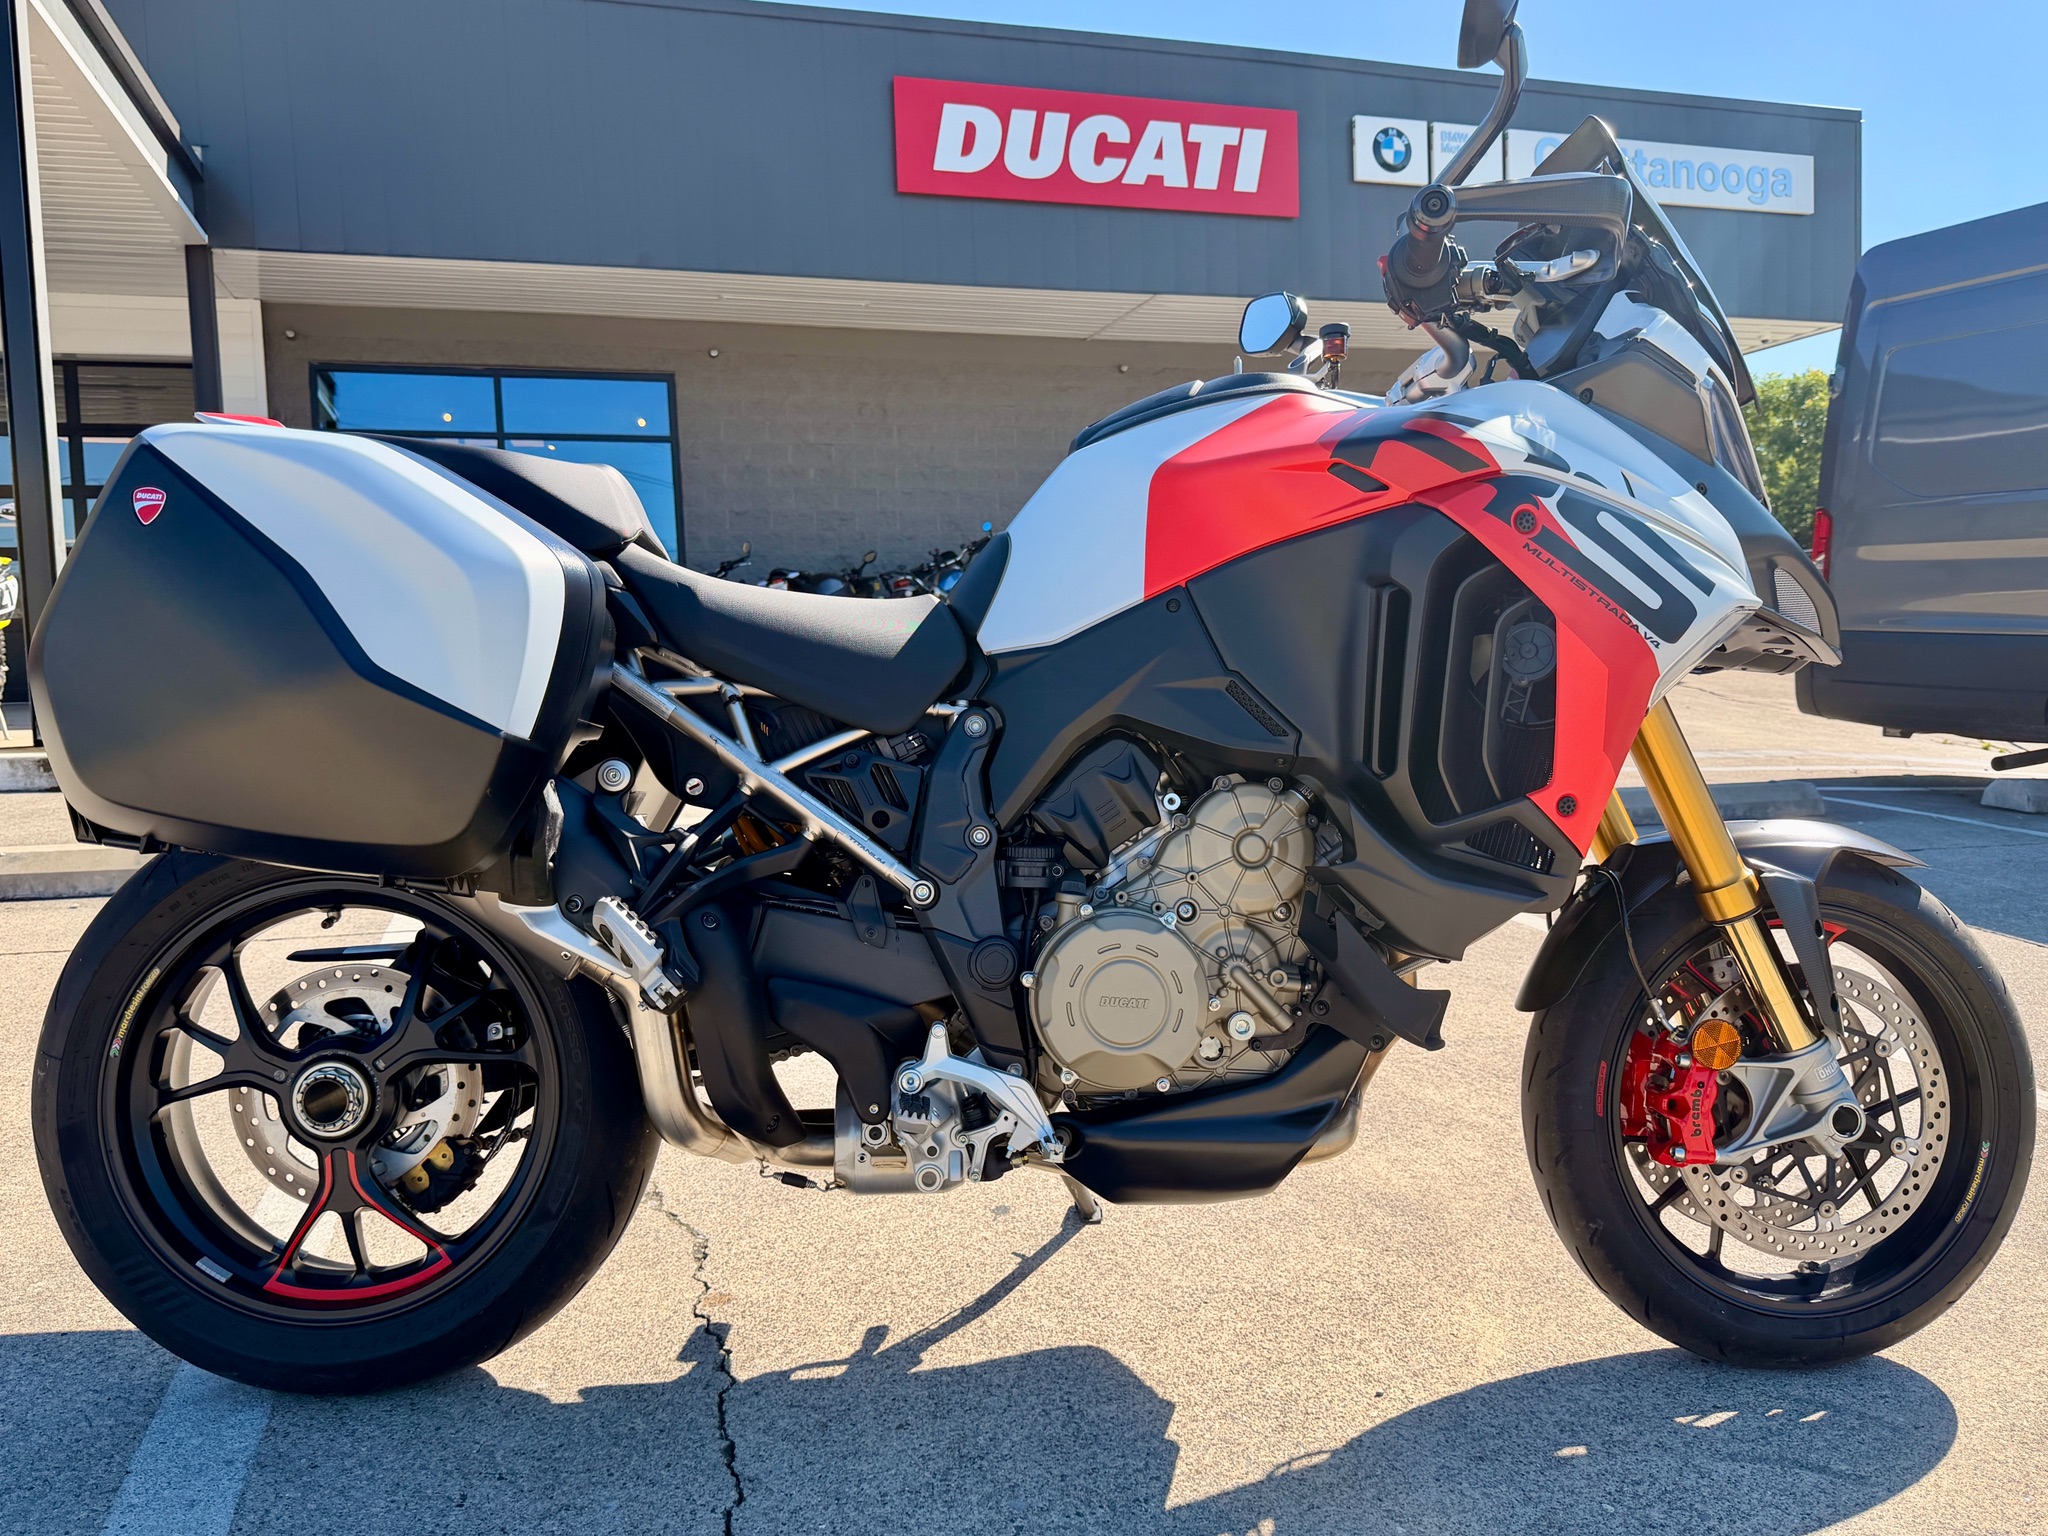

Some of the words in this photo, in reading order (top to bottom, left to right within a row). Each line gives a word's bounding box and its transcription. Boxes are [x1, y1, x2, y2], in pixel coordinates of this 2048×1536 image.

[933, 103, 1267, 193] DUCATI
[1376, 128, 1409, 146] BMW
[1440, 131, 1469, 143] BMW
[1534, 136, 1793, 205] Ctanooga
[136, 492, 162, 500] DUCATI
[1522, 542, 1640, 634] MULTISTRADA
[1644, 632, 1661, 649] V4
[849, 835, 886, 865] TITANIUM
[117, 989, 144, 1038] marchesini
[141, 967, 160, 992] FORGED
[1099, 995, 1149, 1009] DUCATI
[552, 986, 582, 1064] ROSSO
[1818, 1060, 1839, 1079] ÖHLI
[1691, 1081, 1705, 1138] brembo
[1966, 1157, 1985, 1202] marchesini
[1954, 1200, 1972, 1224] FORGED
